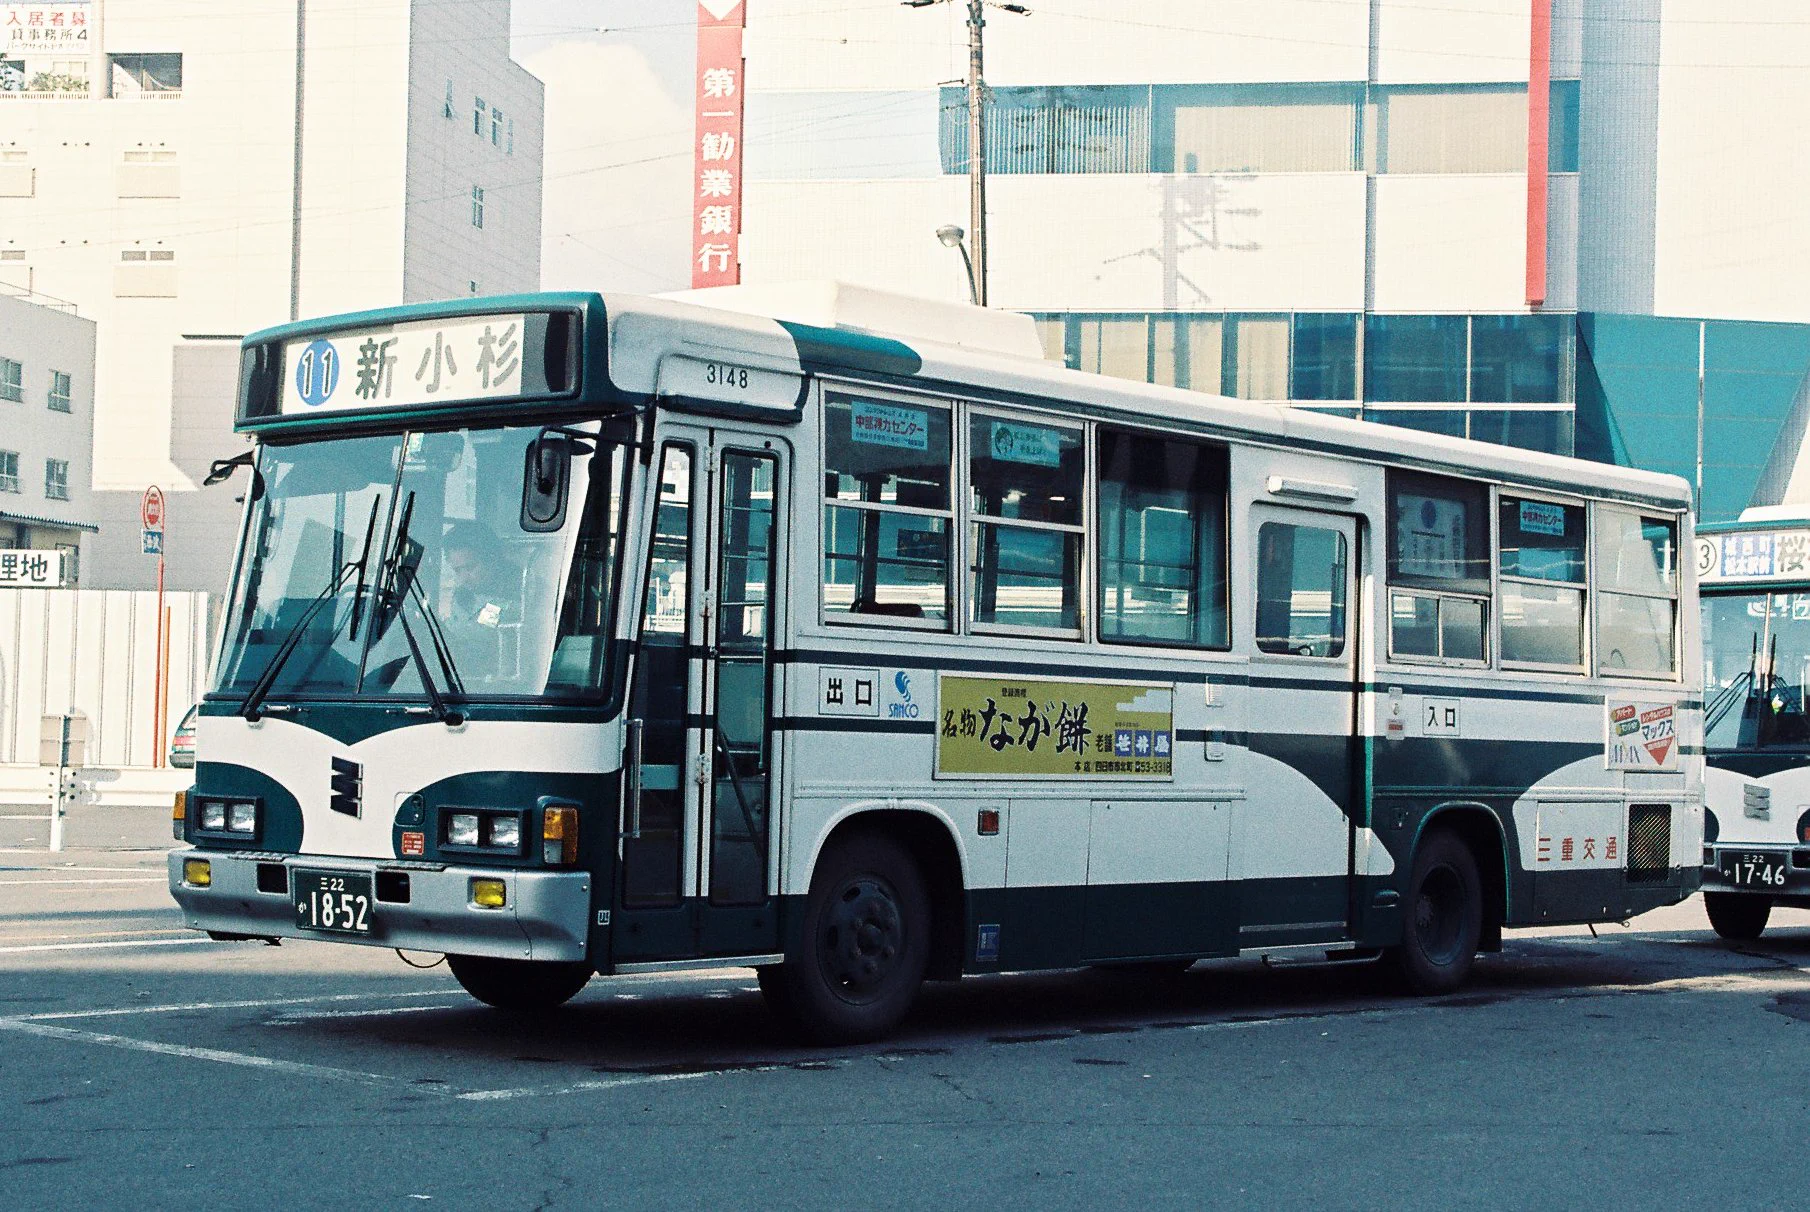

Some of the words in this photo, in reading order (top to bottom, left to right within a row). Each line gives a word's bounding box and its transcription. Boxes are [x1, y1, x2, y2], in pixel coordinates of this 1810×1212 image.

[697, 67, 736, 273] 第一勧業銀行
[301, 348, 334, 399] 11
[355, 322, 519, 400] 新小杉
[706, 364, 748, 389] 3148
[1698, 544, 1711, 570] 3
[826, 677, 873, 707] 出口
[888, 703, 920, 719] SANCO
[1427, 705, 1456, 728] 入口
[942, 708, 977, 738] 名物
[978, 697, 1092, 756] なが餅
[1641, 719, 1674, 740] マックス
[1537, 836, 1618, 861] 三重交通
[1735, 863, 1785, 885] 17-46
